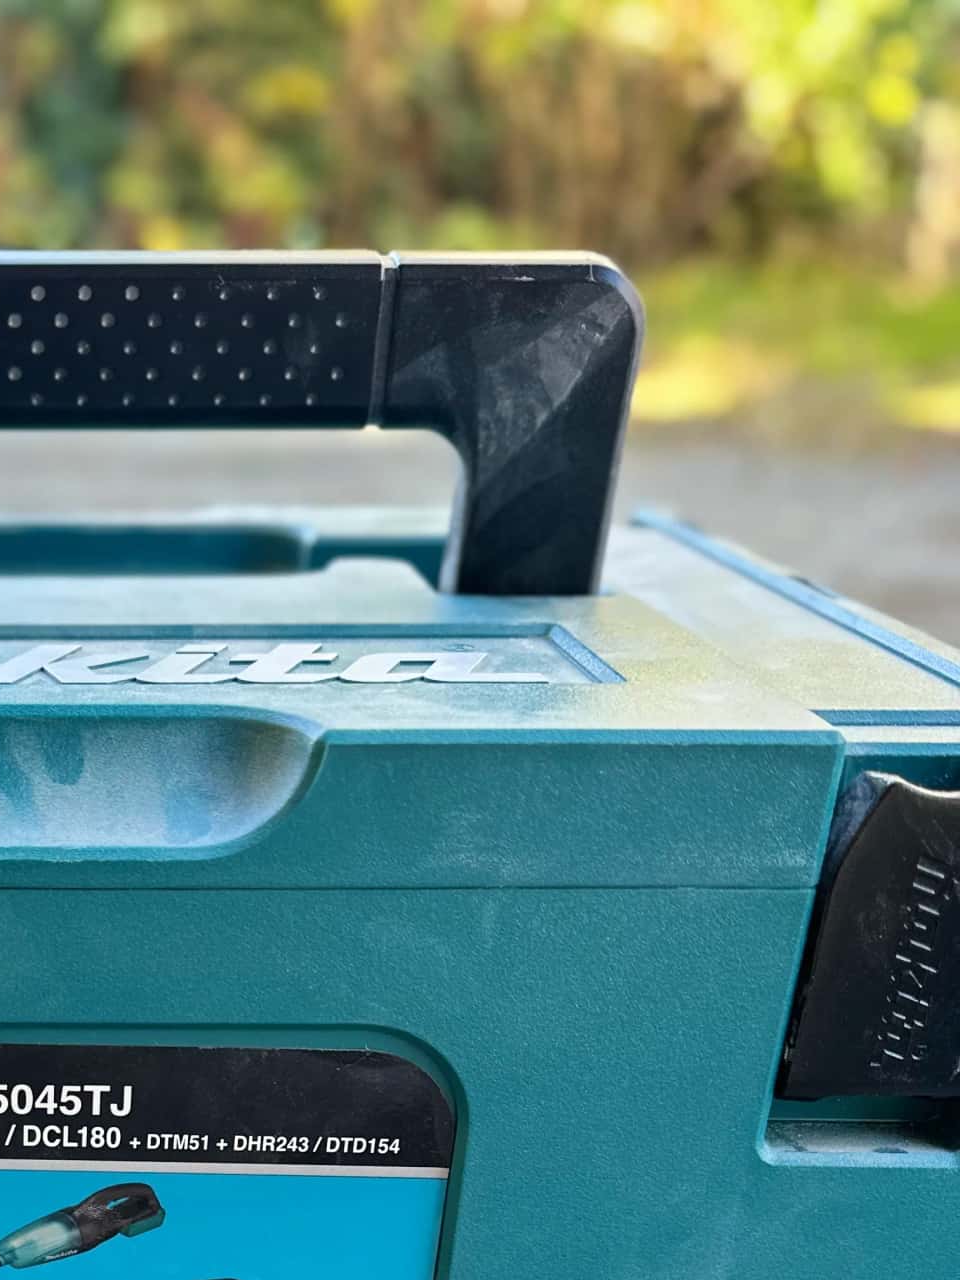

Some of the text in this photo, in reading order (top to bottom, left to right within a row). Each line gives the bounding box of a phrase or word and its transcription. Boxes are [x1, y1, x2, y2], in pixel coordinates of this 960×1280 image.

[23, 1125, 122, 1149] DCL180
[147, 1134, 209, 1150] DTM51
[234, 1135, 309, 1153] DHR243
[326, 1138, 401, 1154] DTD154
